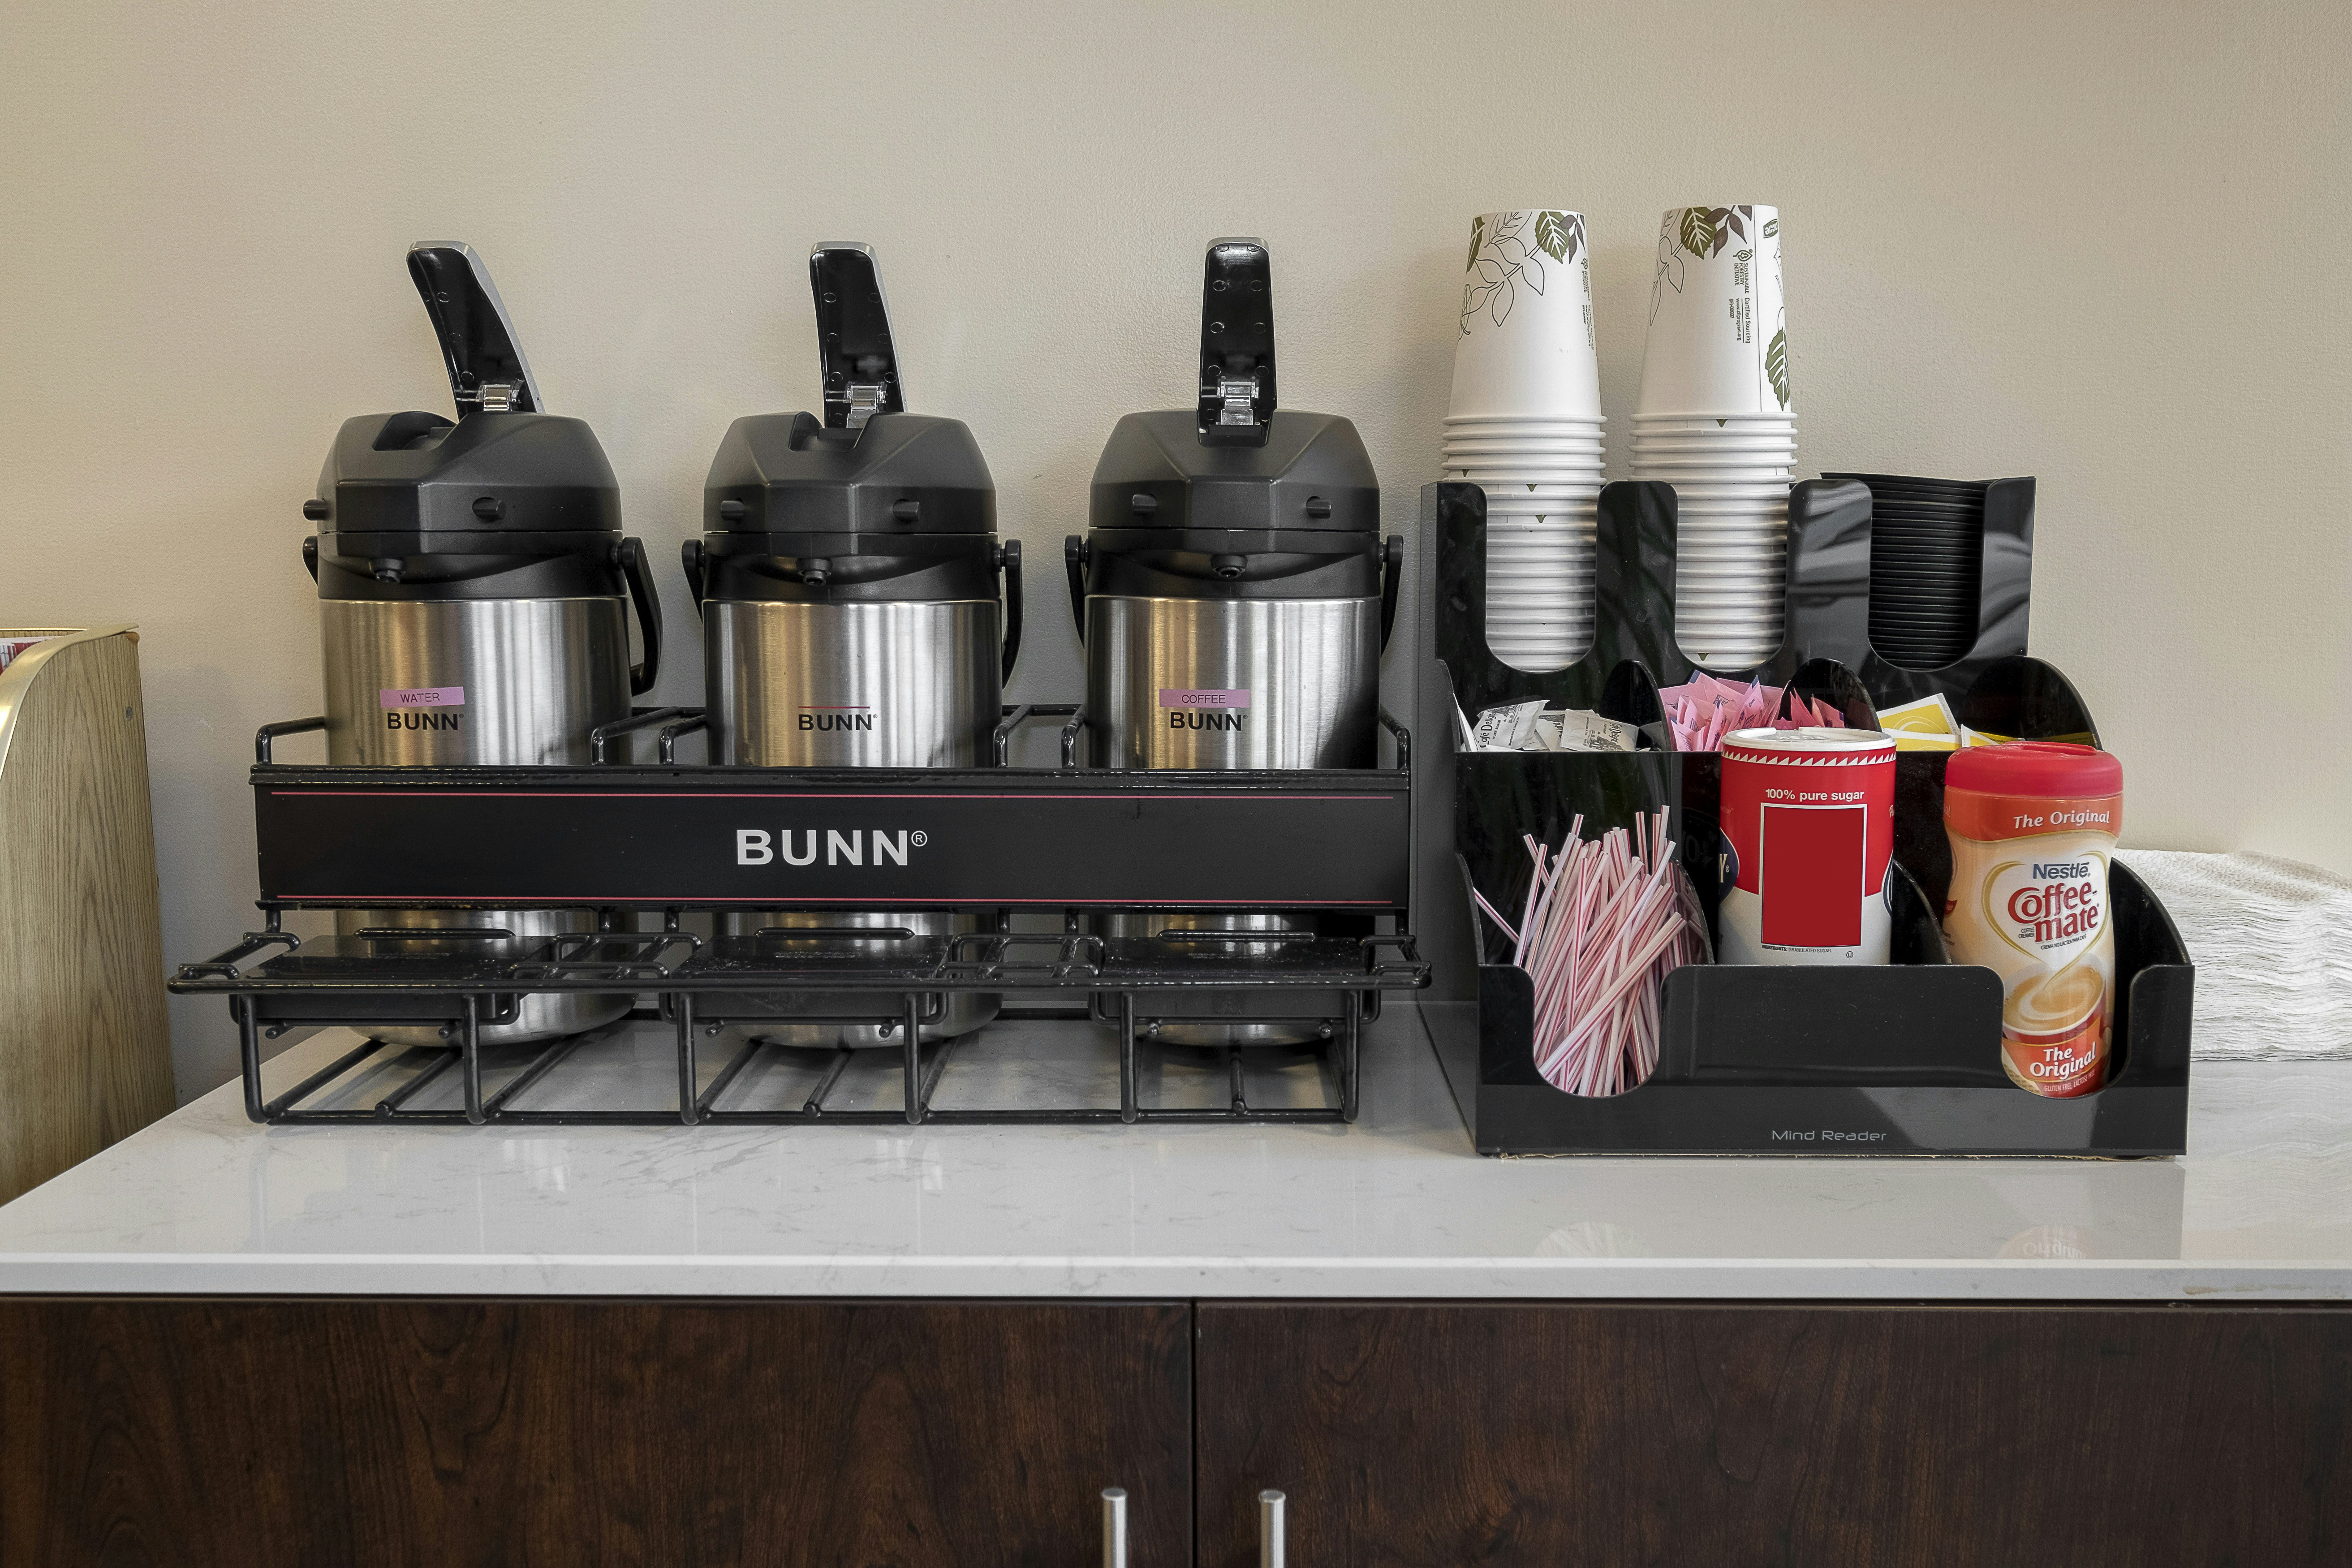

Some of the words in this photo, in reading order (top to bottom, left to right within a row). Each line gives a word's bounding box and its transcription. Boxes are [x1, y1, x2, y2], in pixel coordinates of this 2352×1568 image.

[400, 692, 440, 703] WATER
[1181, 694, 1226, 704] COFFEE
[1766, 788, 1796, 800] 100%
[1800, 792, 1828, 802] pure
[1831, 792, 1865, 802] sugar
[2013, 814, 2043, 829] The
[2050, 810, 2110, 826] Original
[2034, 906, 2098, 942] mate
[2030, 1041, 2096, 1080] Original
[2043, 1047, 2072, 1062] The
[2062, 1082, 2073, 1091] FREE,
[2074, 1074, 2088, 1088] LACTOSE
[1772, 1130, 1815, 1140] Mind
[1822, 1130, 1887, 1141] Reader
